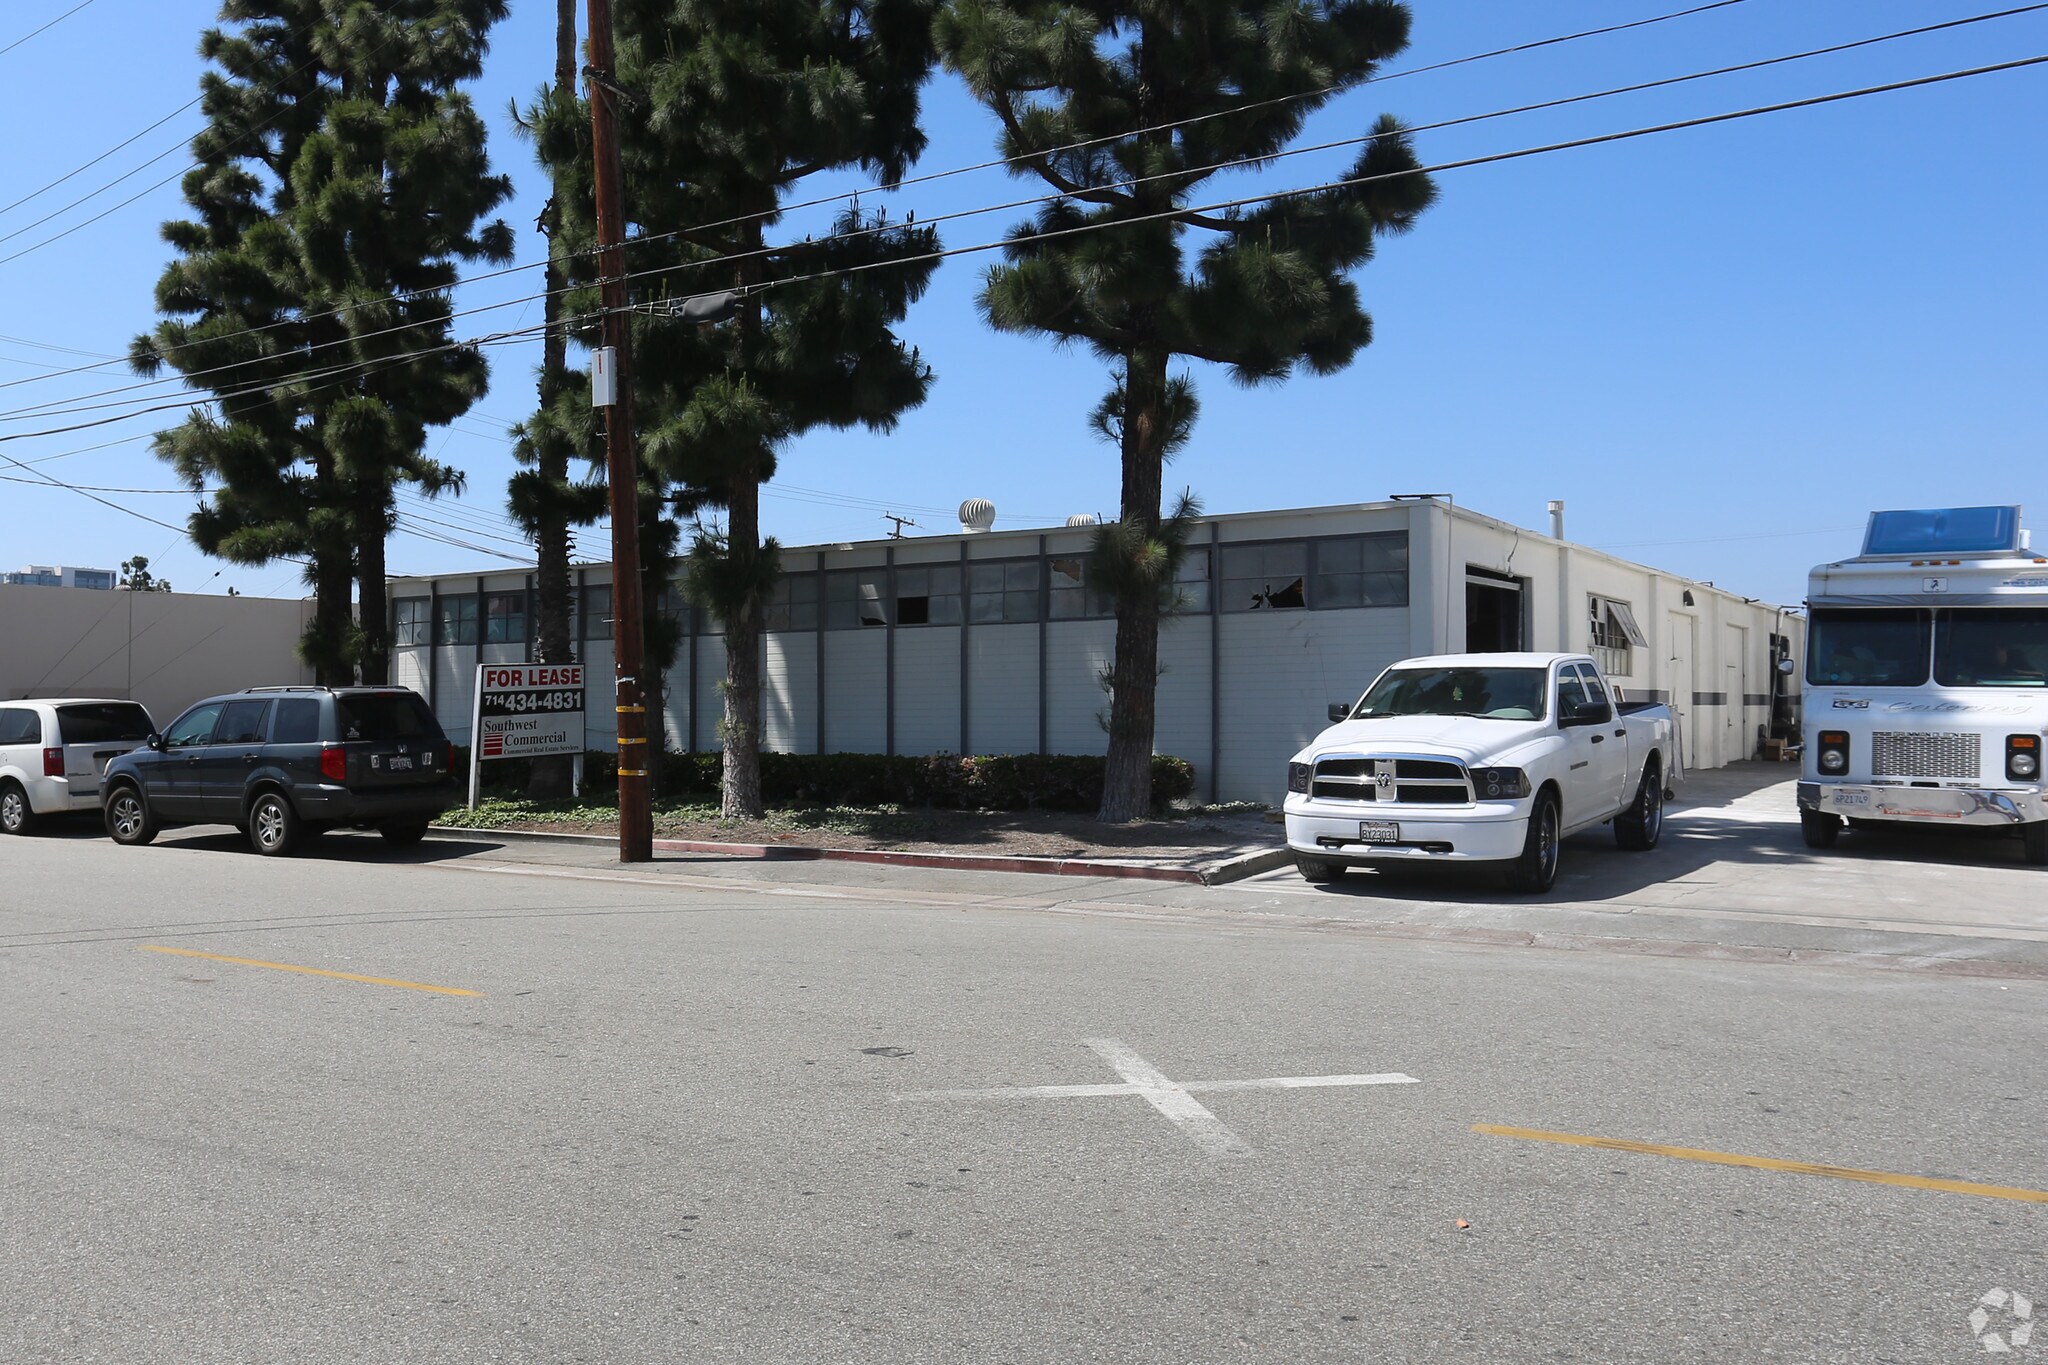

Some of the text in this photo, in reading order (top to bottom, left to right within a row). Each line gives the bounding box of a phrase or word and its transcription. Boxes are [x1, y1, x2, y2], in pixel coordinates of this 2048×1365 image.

[486, 668, 581, 687] FOR LEASE
[485, 691, 581, 711] 714 434-4831
[484, 719, 537, 732] Southwest
[504, 731, 566, 746] Commercial
